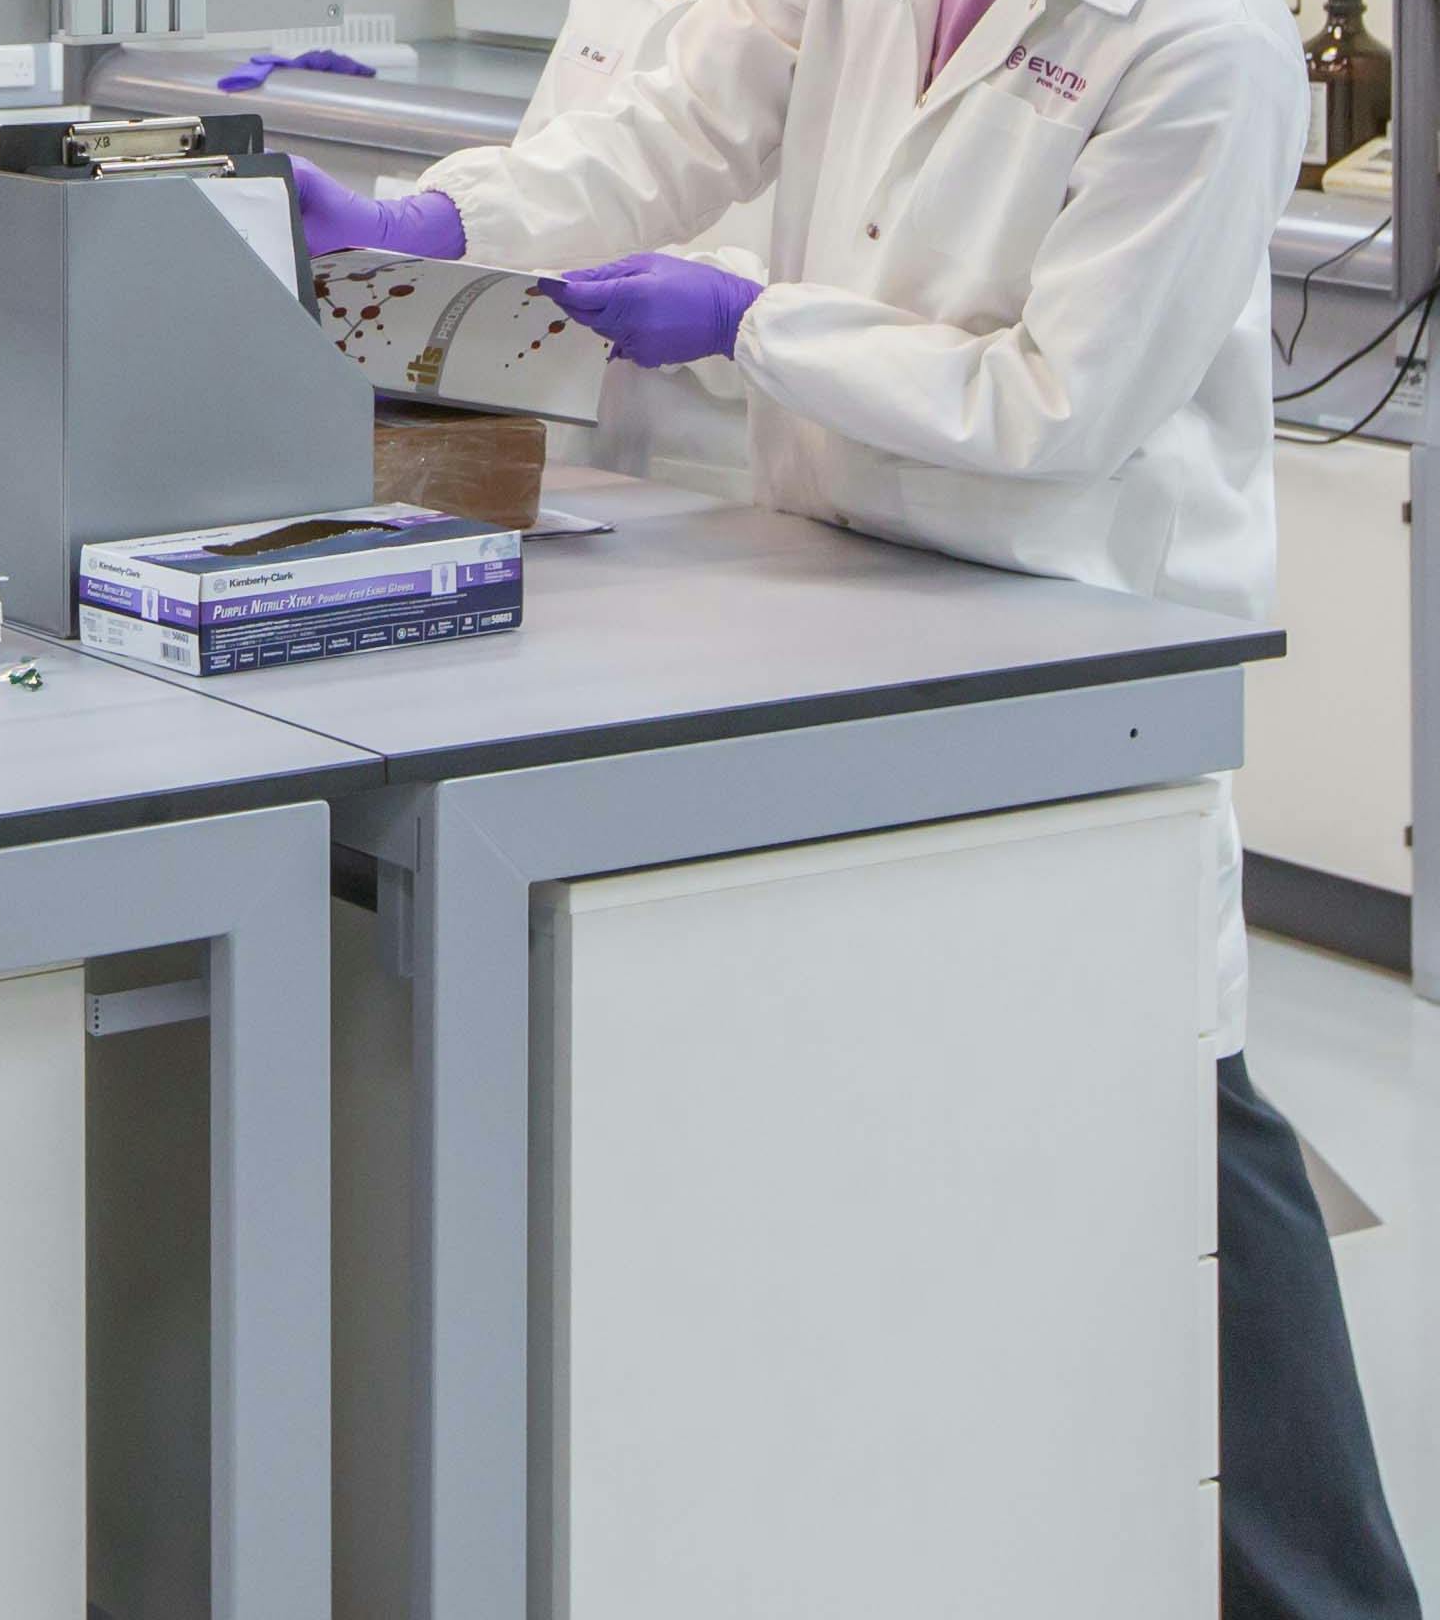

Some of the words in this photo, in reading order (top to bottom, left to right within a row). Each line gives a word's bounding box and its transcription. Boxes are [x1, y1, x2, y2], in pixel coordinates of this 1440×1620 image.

[99, 561, 141, 579] Kimberly-Clark
[466, 566, 474, 582] L
[229, 571, 294, 589] Kimberly-Clark
[366, 585, 387, 598] Exam
[388, 582, 416, 594] Gloves
[164, 598, 170, 613] L
